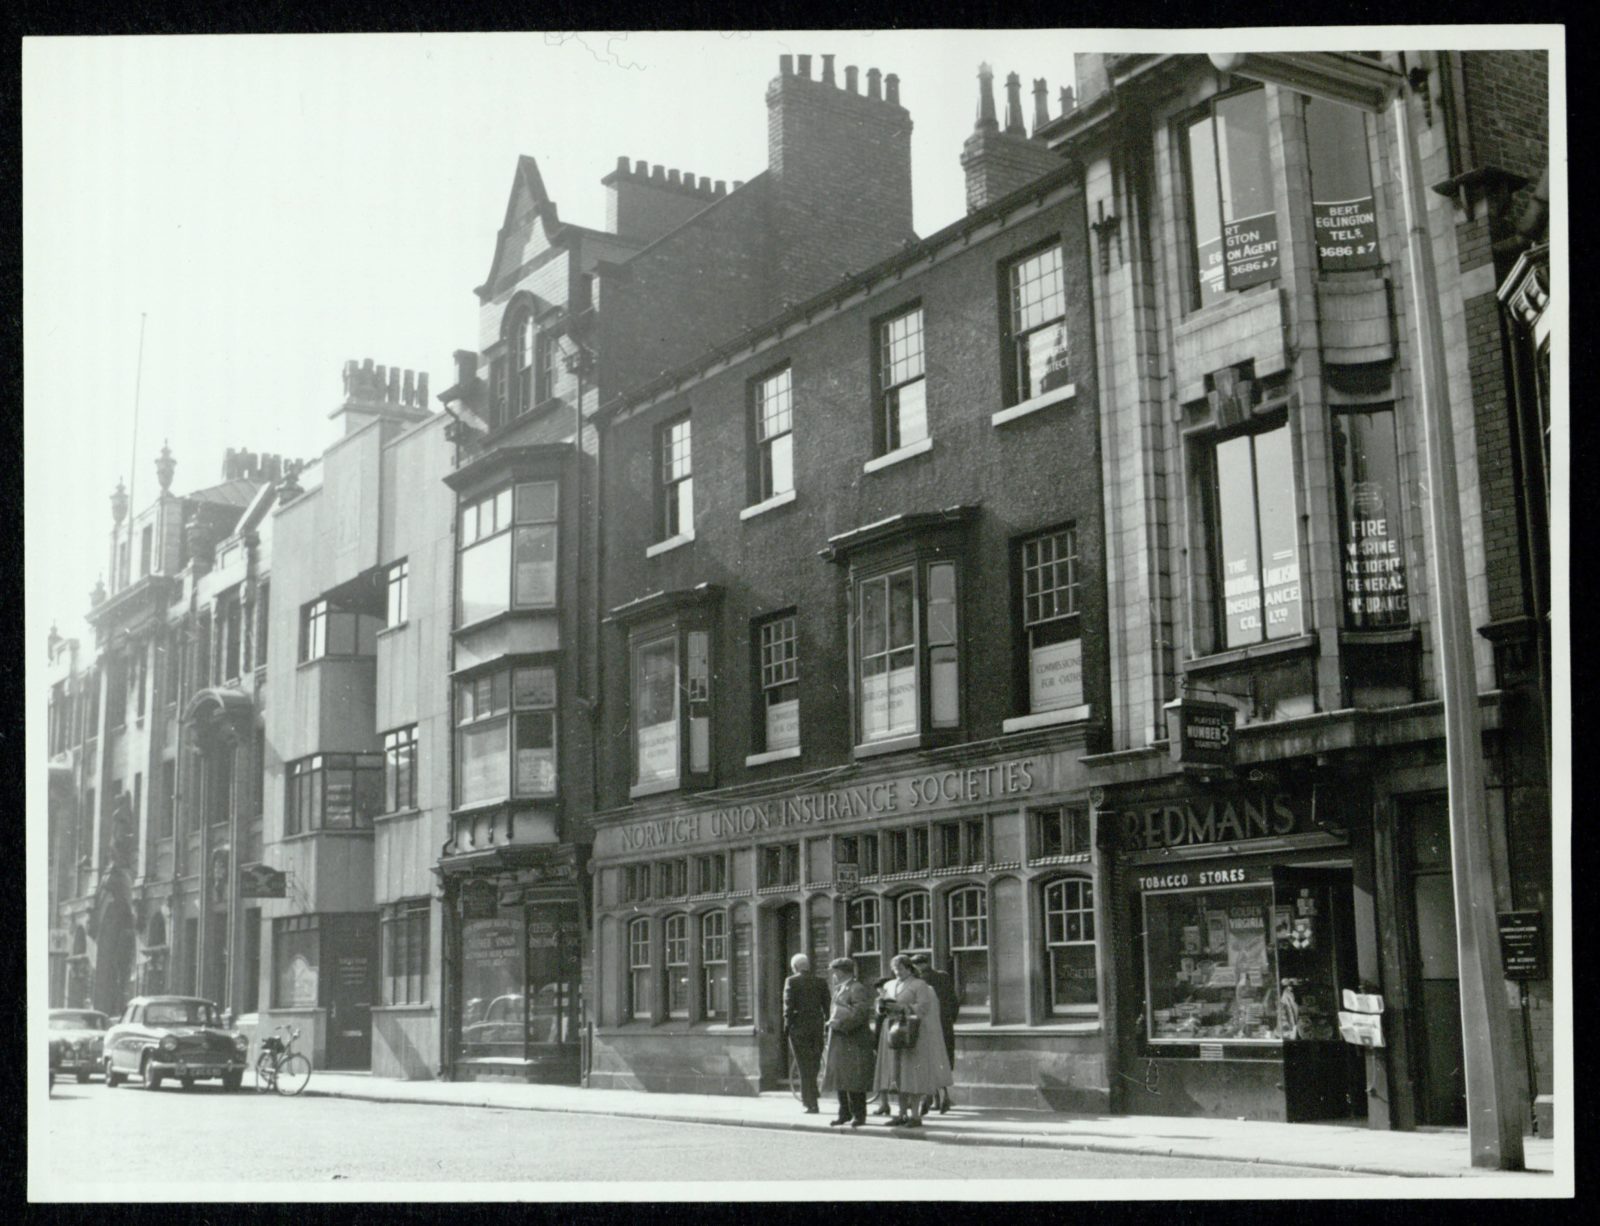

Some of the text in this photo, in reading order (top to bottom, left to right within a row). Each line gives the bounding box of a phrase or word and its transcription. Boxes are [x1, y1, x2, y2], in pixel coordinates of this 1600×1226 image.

[1329, 205, 1360, 216] BERT
[1316, 213, 1374, 228] EGLINGTON
[1243, 241, 1278, 258] AGENT
[1320, 246, 1352, 258] 3686
[1367, 242, 1376, 252] 7
[1231, 261, 1261, 276] 3686
[1270, 257, 1278, 267] 7
[1351, 519, 1387, 537] FIRE
[1228, 559, 1248, 575] THE
[1221, 725, 1229, 745] 3
[621, 760, 1033, 851] NORWICH UNION INSURANCE SOCIETIES
[1121, 794, 1295, 849] REDMANS
[1139, 869, 1245, 889] TOBACCO STORES
